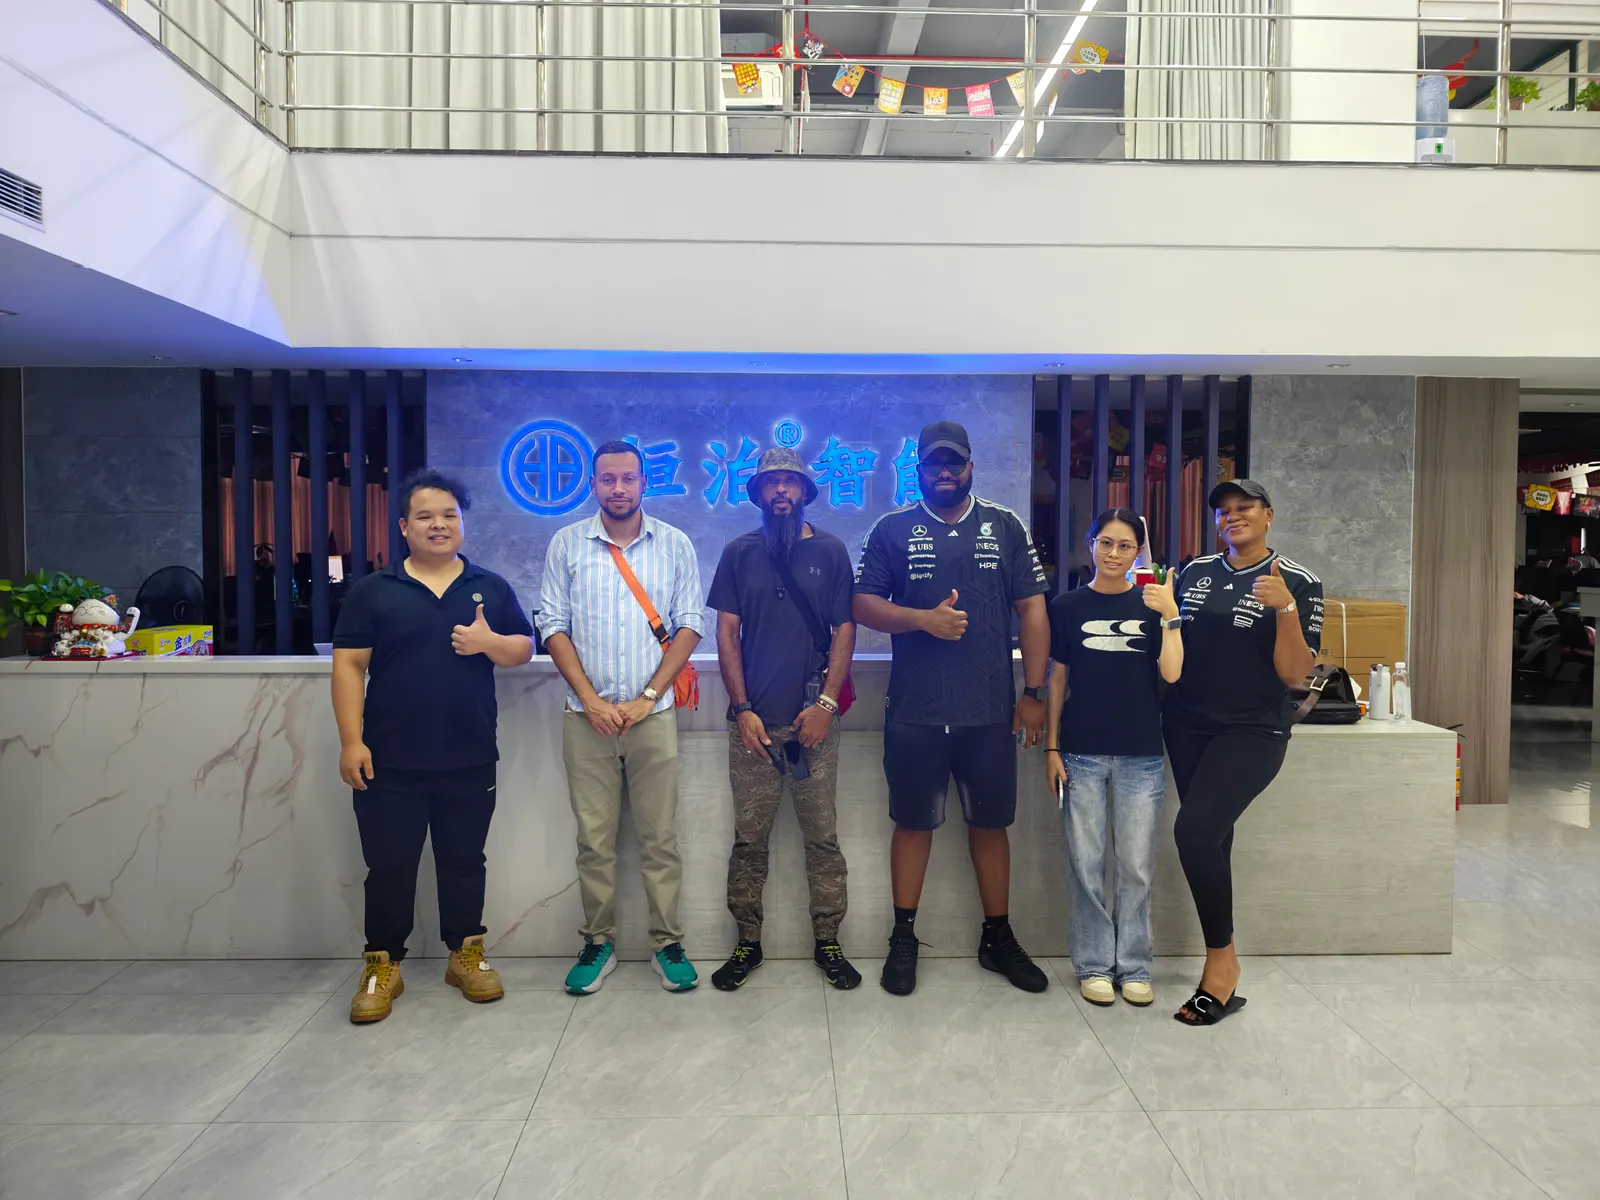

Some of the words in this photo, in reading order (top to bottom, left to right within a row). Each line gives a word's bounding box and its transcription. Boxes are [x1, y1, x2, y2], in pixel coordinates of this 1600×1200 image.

[917, 543, 934, 551] UBS
[975, 542, 999, 551] INEOS
[979, 562, 998, 570] HPE
[1238, 599, 1264, 610] INEOS
